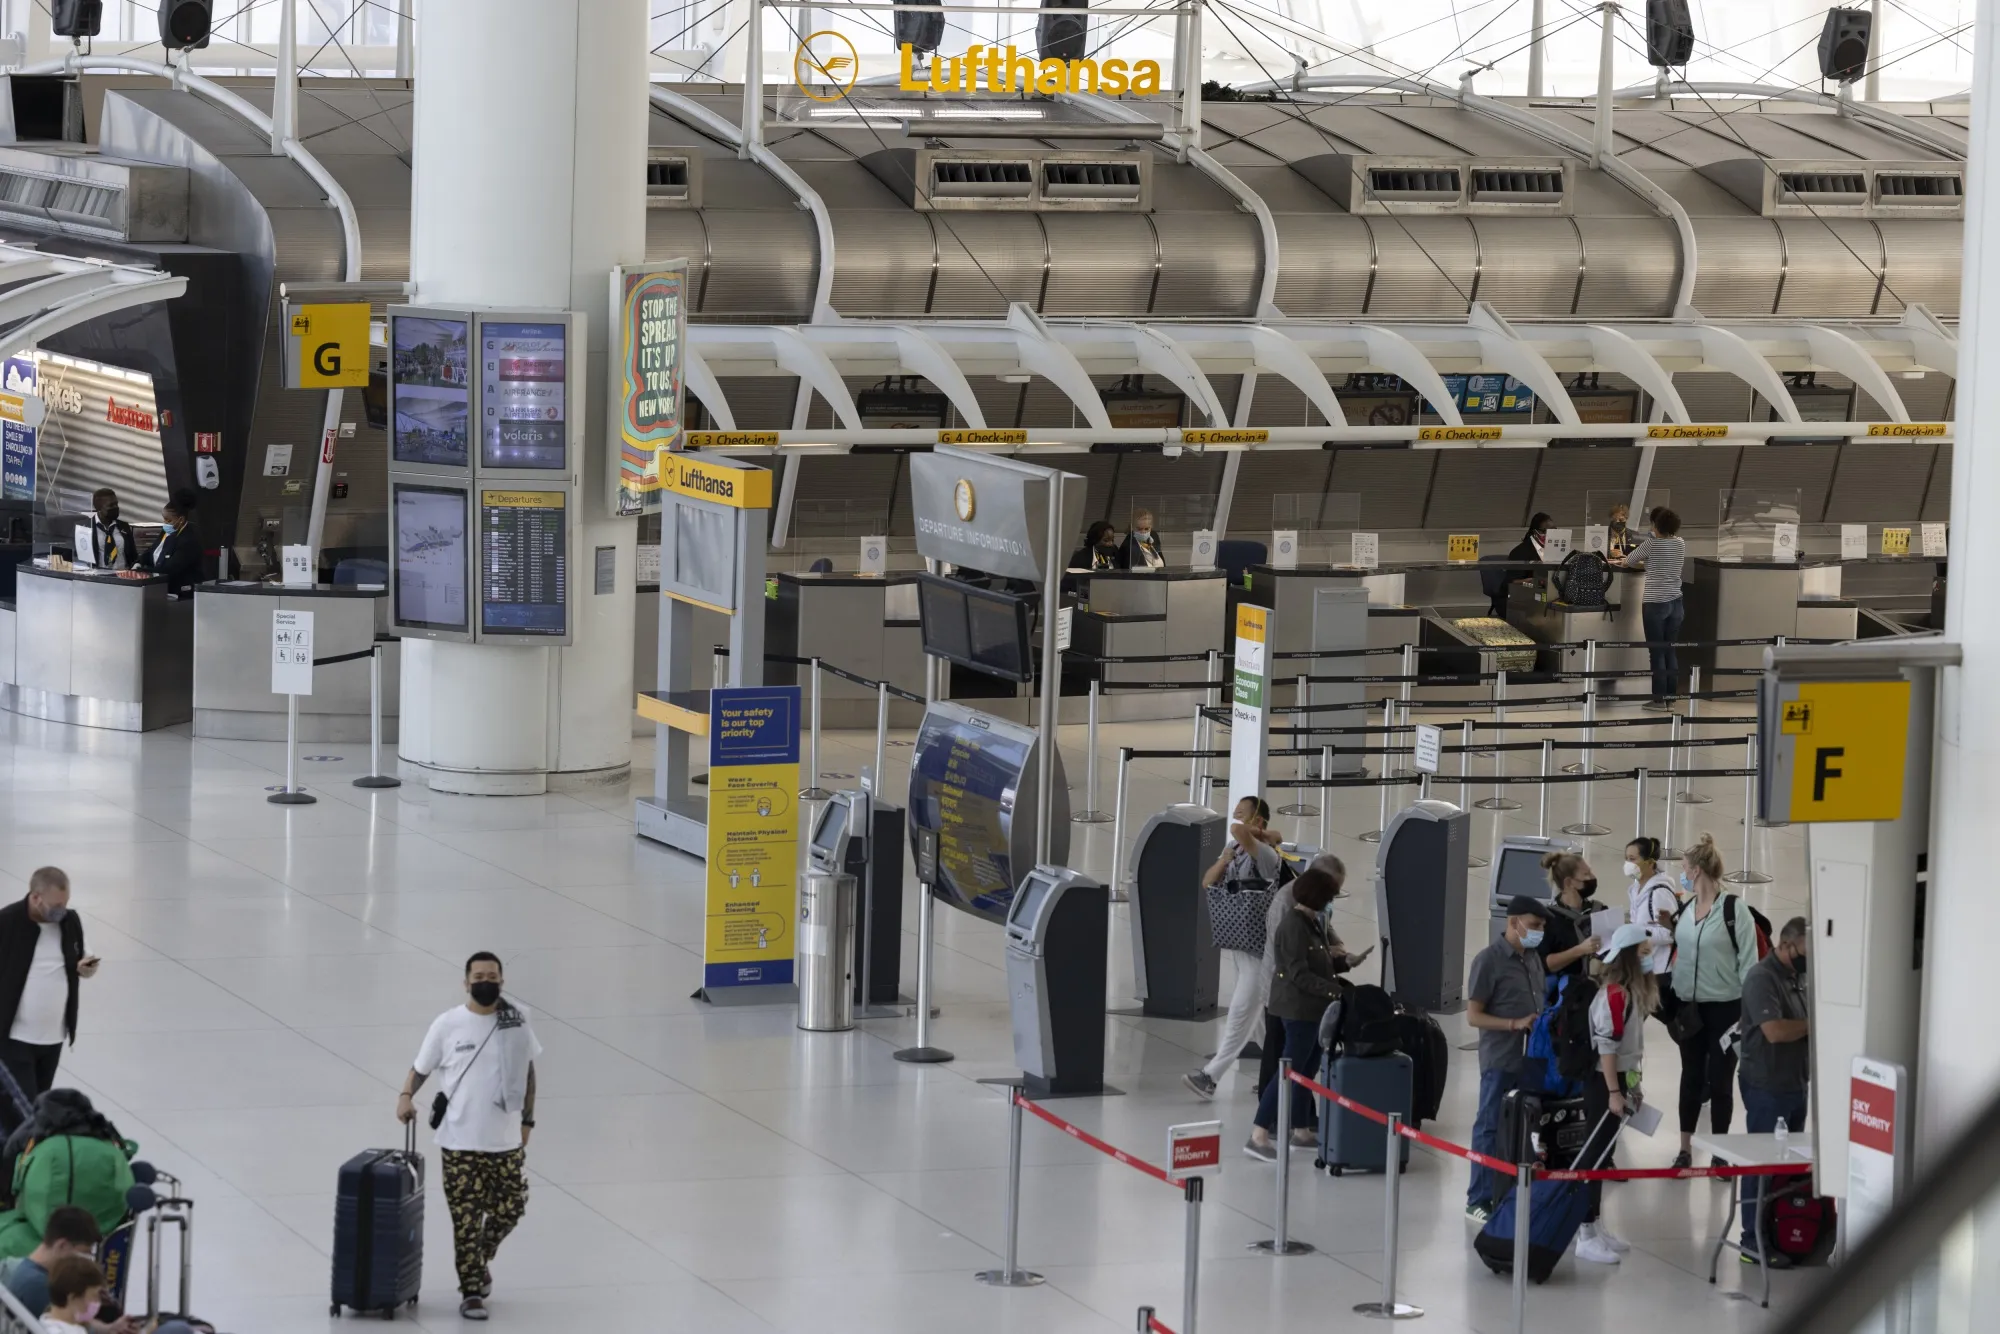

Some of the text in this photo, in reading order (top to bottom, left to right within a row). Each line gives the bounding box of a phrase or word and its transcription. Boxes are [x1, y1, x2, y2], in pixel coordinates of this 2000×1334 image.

[900, 42, 1160, 96] Lufthansa
[642, 296, 678, 320] STOP THE
[314, 342, 341, 376] G
[642, 348, 675, 368] IT'S UP
[646, 372, 658, 391] TO
[38, 378, 82, 414] Tickets
[487, 384, 494, 394] A
[106, 396, 153, 432] Austrian
[639, 399, 656, 418] NEW
[6, 431, 24, 443] SMILE BY
[504, 430, 543, 440] volaris
[942, 432, 1013, 443] G 4 Check-in
[1186, 432, 1254, 443] G 5 Check-in
[1422, 429, 1489, 440] G 6 Check-in
[1649, 428, 1715, 438] G 7 Check-in
[1870, 426, 1934, 436] G 8 Check-in
[690, 434, 764, 445] G 3 Check-in
[680, 465, 734, 498] Lufthansa
[498, 495, 542, 504] Departures
[919, 517, 1026, 556] DEPARTURE INFORMATION
[1243, 619, 1263, 630] Lufthansa
[1237, 655, 1260, 672] Austrian
[1236, 674, 1259, 692] Economy
[1235, 686, 1248, 700] Class
[721, 708, 774, 717] Your safety
[1234, 708, 1257, 722] Check-in
[721, 719, 729, 727] is
[749, 718, 764, 727] top
[721, 728, 755, 739] priority
[1812, 747, 1844, 802] F
[1852, 1098, 1870, 1114] SKY
[1852, 1110, 1890, 1132] PRIORITY
[1175, 1145, 1190, 1154] SKY
[1175, 1150, 1211, 1162] PRIORITY
